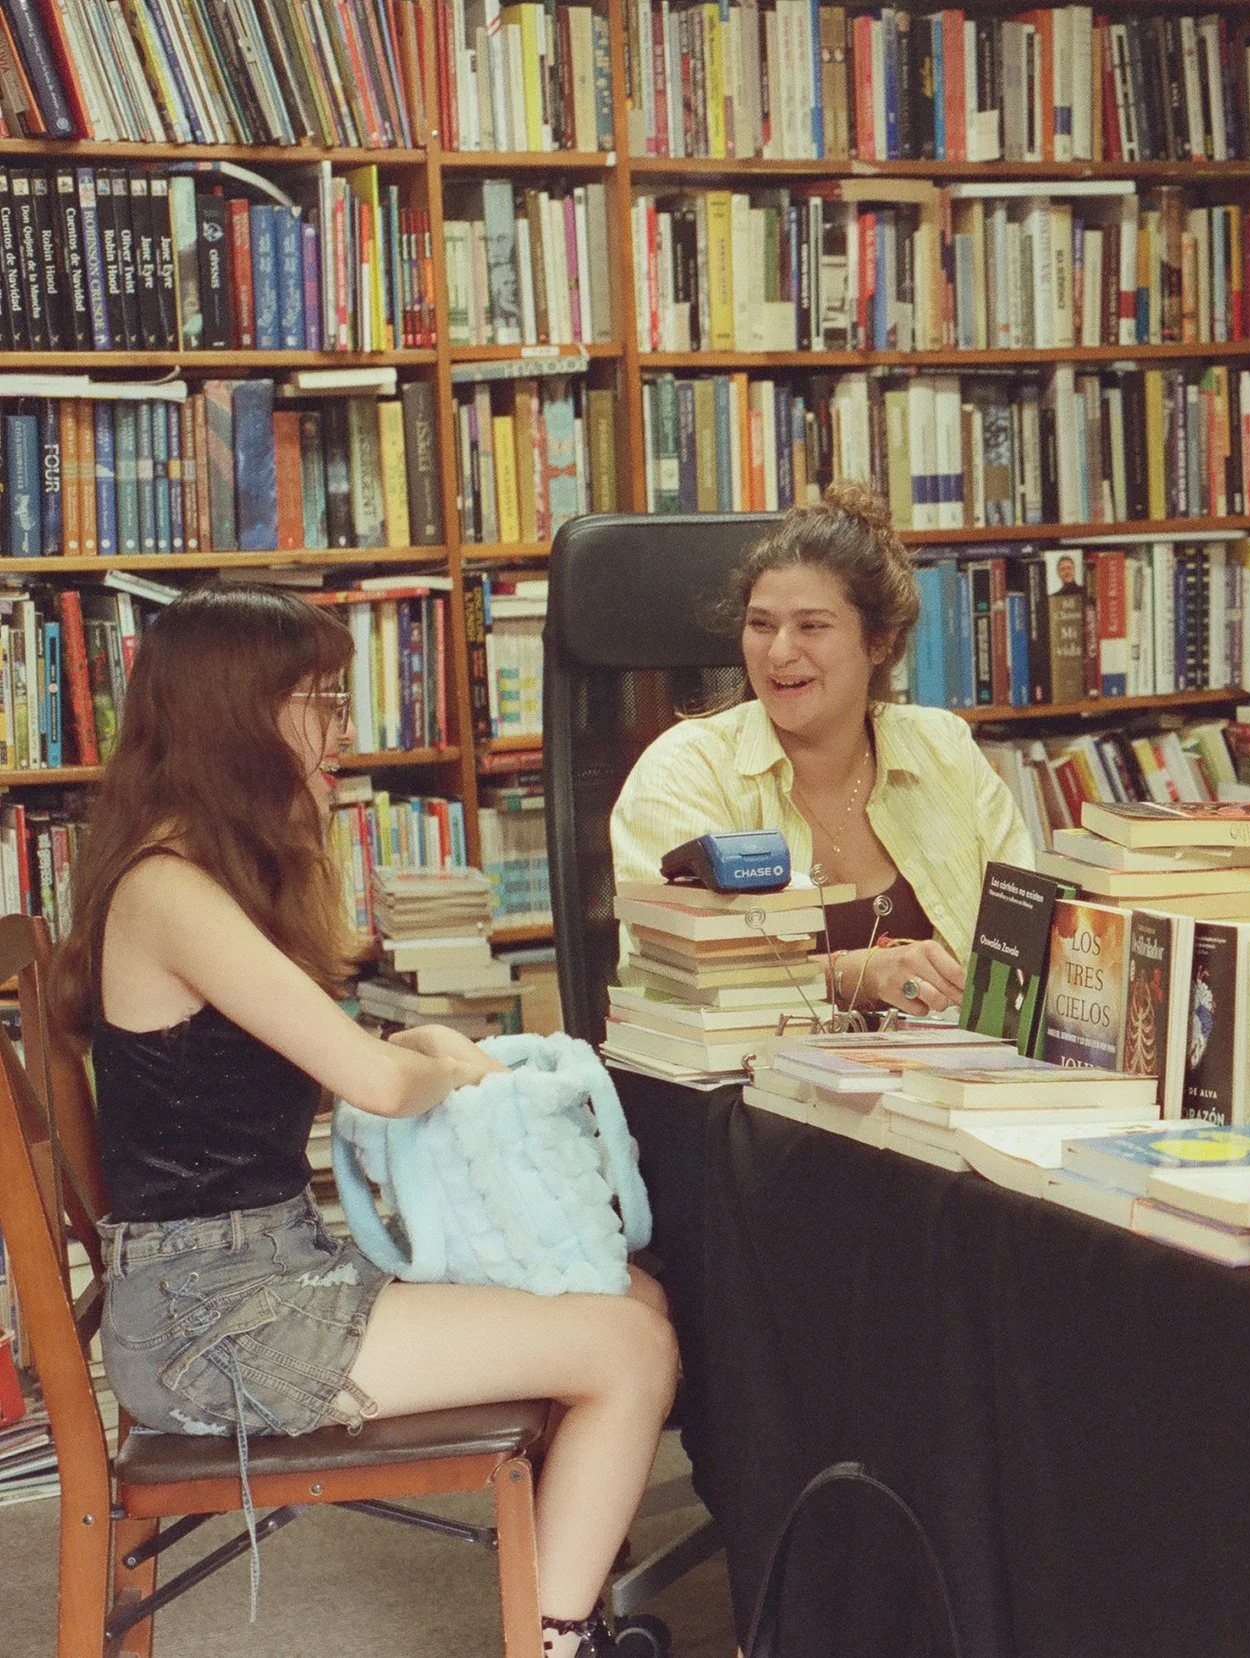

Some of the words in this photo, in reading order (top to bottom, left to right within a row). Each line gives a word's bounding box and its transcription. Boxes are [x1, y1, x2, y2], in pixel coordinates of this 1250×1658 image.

[21, 205, 30, 223] Don
[1, 207, 12, 250] Cuentos
[23, 225, 34, 258] Quijote
[66, 207, 77, 250] Cuentos
[42, 229, 53, 261] Robin
[84, 210, 100, 276] ROBINSON
[104, 229, 116, 261] Robin
[121, 229, 132, 263] Oliver
[141, 235, 152, 261] Jane
[161, 235, 171, 261] Jane
[6, 252, 15, 265] de
[27, 260, 36, 270] de
[70, 252, 81, 266] de
[8, 268, 22, 312] Navidad
[29, 272, 37, 281] la
[45, 265, 57, 294] Hood
[72, 269, 85, 312] Navidad
[107, 265, 119, 295] Hood
[124, 266, 135, 294] Twist
[141, 264, 154, 289] Eyre
[161, 264, 173, 289] Eyre
[30, 283, 40, 319] Mancha
[89, 277, 105, 330] CRUSOE
[44, 443, 60, 493] FOUR
[734, 867, 772, 878] CHASE
[991, 876, 1000, 888] Los
[1018, 888, 1026, 897] no
[1001, 940, 1020, 957] Zavala
[1072, 930, 1101, 956] LOS
[1064, 961, 1104, 992] TRES
[1055, 993, 1111, 1028] CIELOS
[1200, 1088, 1218, 1100] ALVA
[1187, 1107, 1225, 1127] RAZÓN
